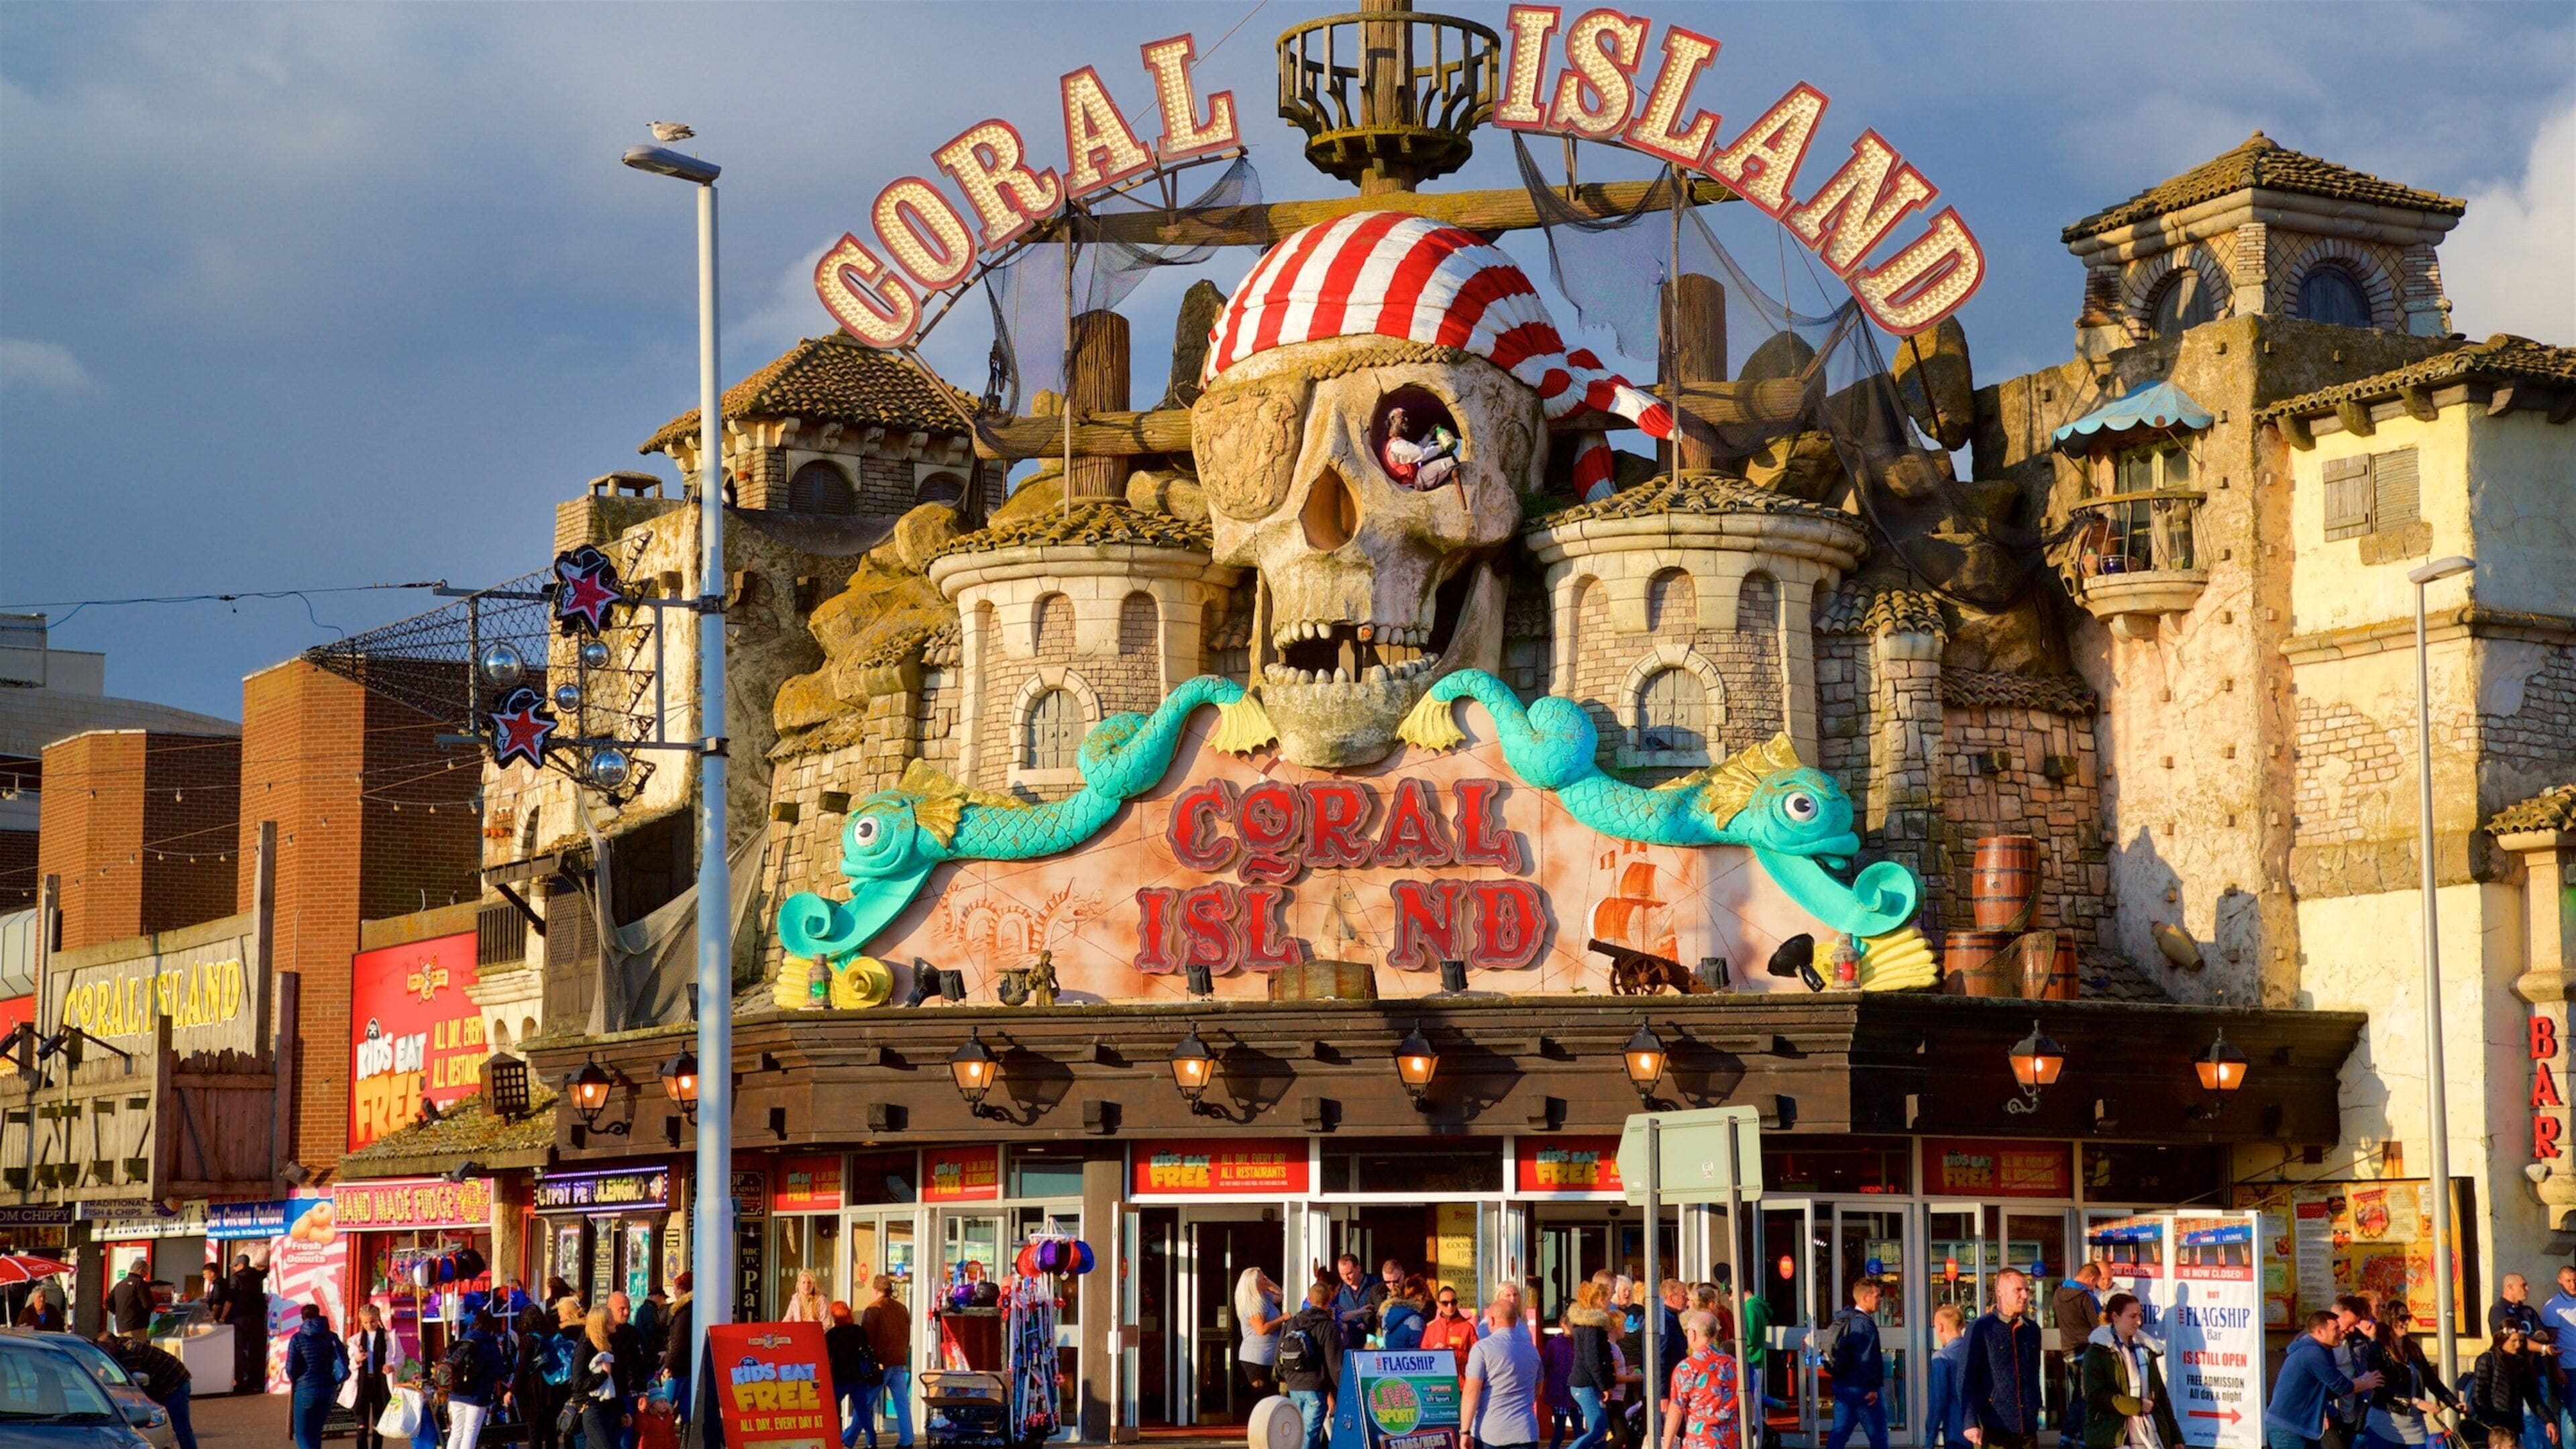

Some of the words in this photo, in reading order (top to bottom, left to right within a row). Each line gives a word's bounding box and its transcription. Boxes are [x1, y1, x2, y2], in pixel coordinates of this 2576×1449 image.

[814, 32, 1245, 350] CORAL
[1492, 3, 1986, 337] ISLAND
[1167, 777, 1520, 885] CORAL
[63, 972, 143, 1042] CORAL
[144, 957, 243, 1034] ISLAND
[434, 1020, 447, 1051] ALL
[357, 1031, 393, 1081] KIDS
[394, 1032, 427, 1075] EAT
[432, 1057, 446, 1089] ALL
[2528, 1016, 2563, 1159] BAR
[354, 1069, 428, 1143] FREE
[1150, 1153, 1181, 1167] KIDS
[1221, 1154, 1234, 1165] ALL
[1252, 1153, 1272, 1165] EVERY
[1536, 1149, 1569, 1165] KIDS
[1148, 1165, 1212, 1188] FREE
[1220, 1166, 1234, 1179] ALL
[1236, 1165, 1287, 1179] RESTAURANTS
[1535, 1161, 1602, 1185] FREE
[1943, 1167, 1994, 1188] FREE
[537, 1183, 572, 1206] GYPSY
[84, 1199, 148, 1208] TRADITIONAL
[84, 1208, 104, 1216] FISH
[114, 1208, 142, 1216] CHIPS
[336, 1189, 372, 1224] HAND
[374, 1187, 413, 1224] MADE
[413, 1183, 454, 1222] FUDGE
[21, 1209, 70, 1222] CHIPPY
[223, 1206, 252, 1227] Cream
[291, 1242, 323, 1251] Fresh
[742, 1248, 760, 1256] BBC
[286, 1254, 327, 1265] Donuts
[2182, 1269, 2190, 1278] IS
[2191, 1269, 2210, 1279] NOW
[2211, 1268, 2244, 1279] CLOSED!
[2207, 1291, 2220, 1299] BUT
[2186, 1305, 2251, 1328] FLAGSHIP
[2206, 1329, 2222, 1341] Bar
[1382, 1356, 1435, 1371] FLAGSHIP
[2183, 1350, 2193, 1364] IS
[2194, 1351, 2220, 1366] STILL
[2222, 1352, 2247, 1367] OPEN
[730, 1362, 777, 1385] KIDS
[778, 1362, 816, 1382] EAT
[2186, 1374, 2202, 1386] FREE
[2204, 1375, 2245, 1389] ADMISSION
[731, 1379, 821, 1413] FREE
[1368, 1383, 1417, 1411] LIVE
[2190, 1387, 2199, 1399] All
[2200, 1388, 2214, 1401] day
[2222, 1390, 2243, 1403] night
[741, 1419, 754, 1432] ALL
[774, 1416, 797, 1430] EVERY
[798, 1415, 812, 1430] DAY
[814, 1415, 824, 1428] AT
[1377, 1408, 1415, 1424] SPORT
